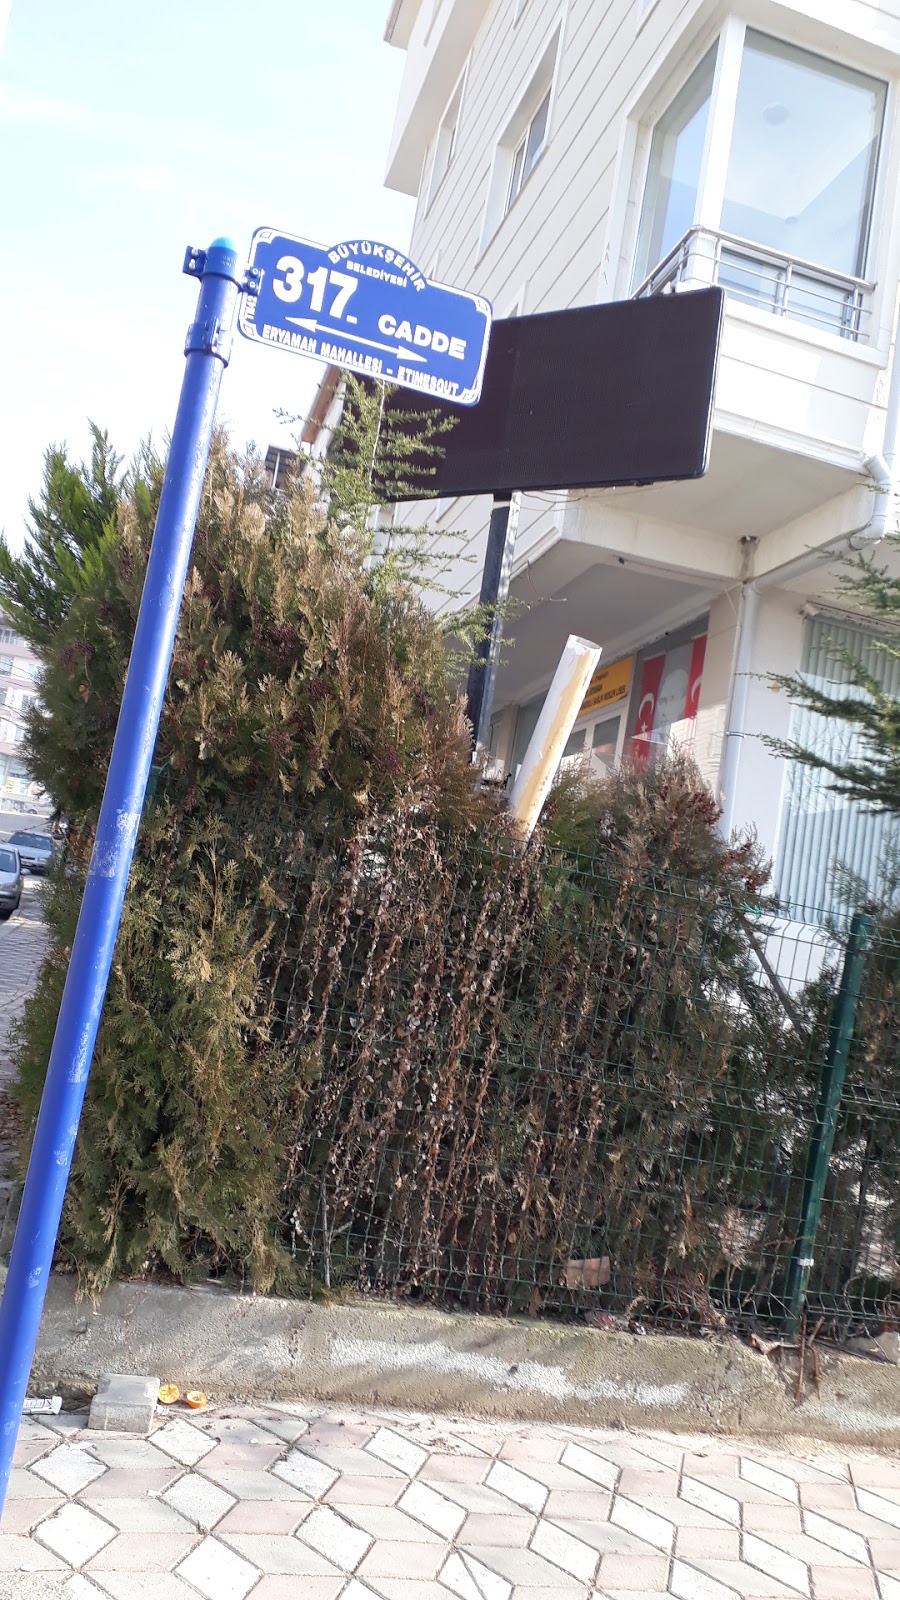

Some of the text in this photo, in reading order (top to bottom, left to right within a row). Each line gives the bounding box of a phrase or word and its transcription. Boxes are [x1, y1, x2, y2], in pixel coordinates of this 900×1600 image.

[328, 241, 425, 292] BÜYÜKŞEHİR
[346, 260, 408, 288] BELEDİYESİ
[272, 255, 467, 361] 317. CADDE
[262, 323, 317, 353] ERYAMAN
